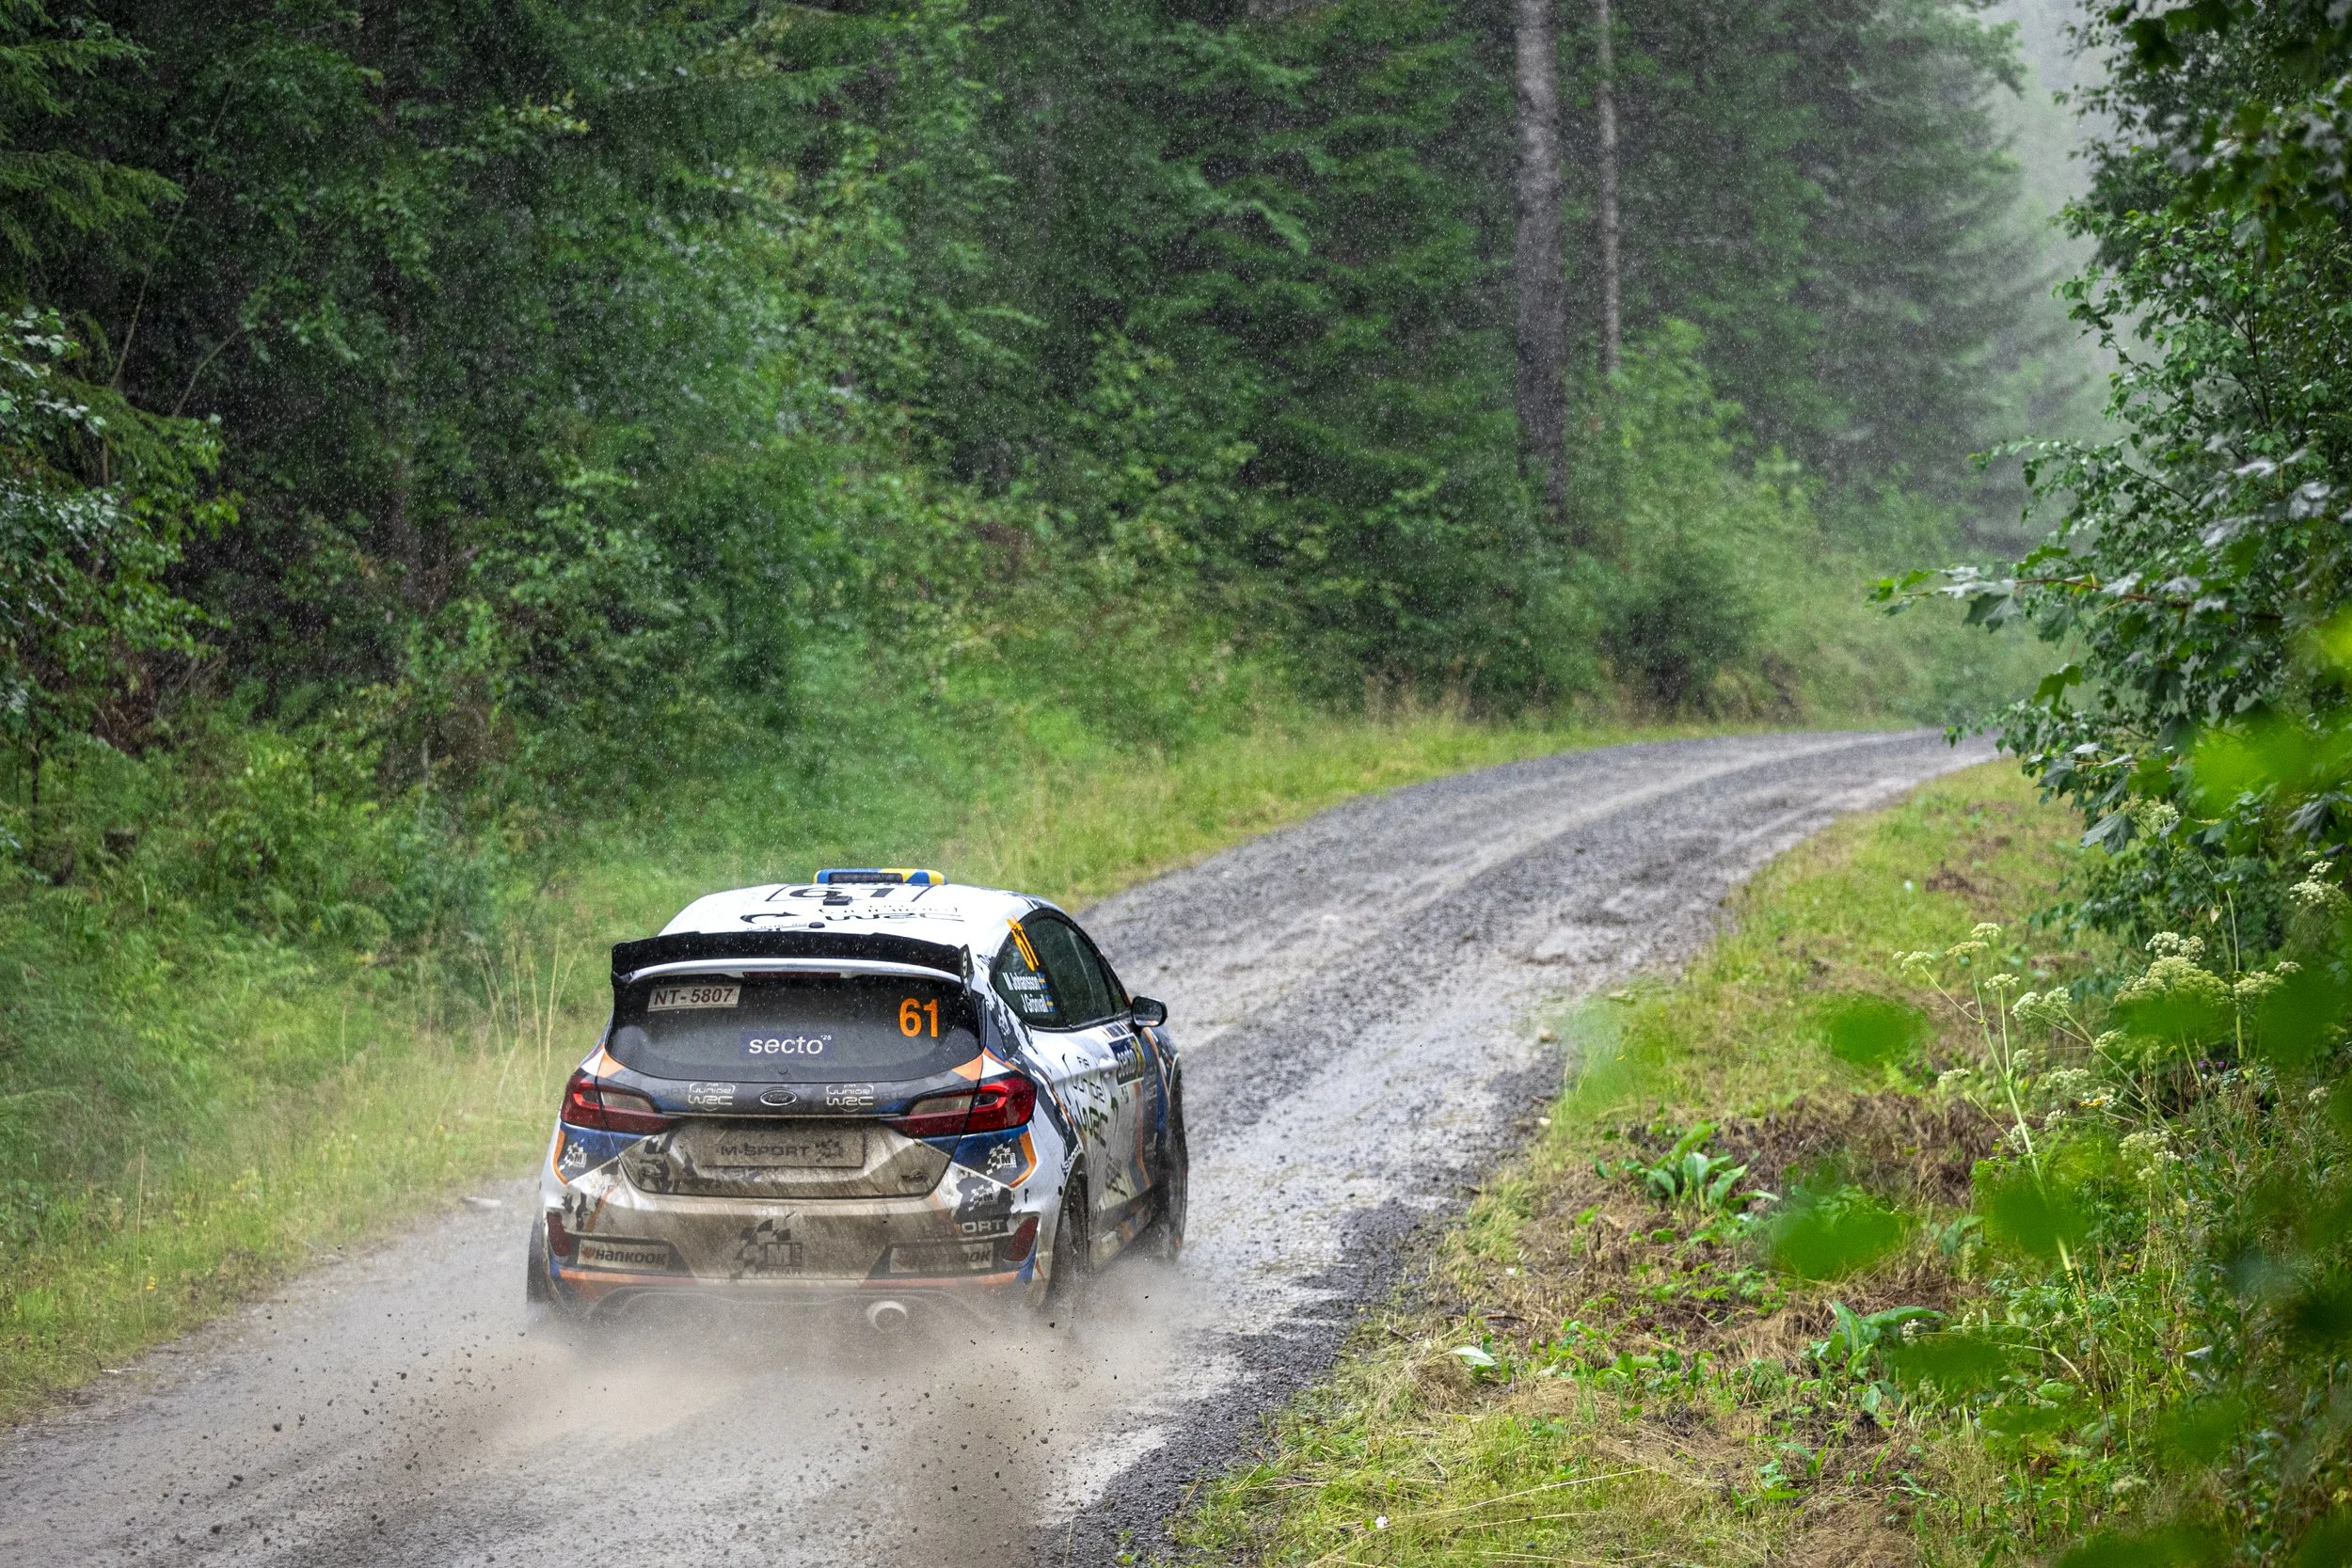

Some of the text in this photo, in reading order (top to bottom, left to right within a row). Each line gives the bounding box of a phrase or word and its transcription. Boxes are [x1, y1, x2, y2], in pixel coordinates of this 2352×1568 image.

[898, 998, 939, 1037] 61
[749, 1036, 824, 1054] secto
[688, 1094, 734, 1105] WRC
[826, 1096, 874, 1106] WRC
